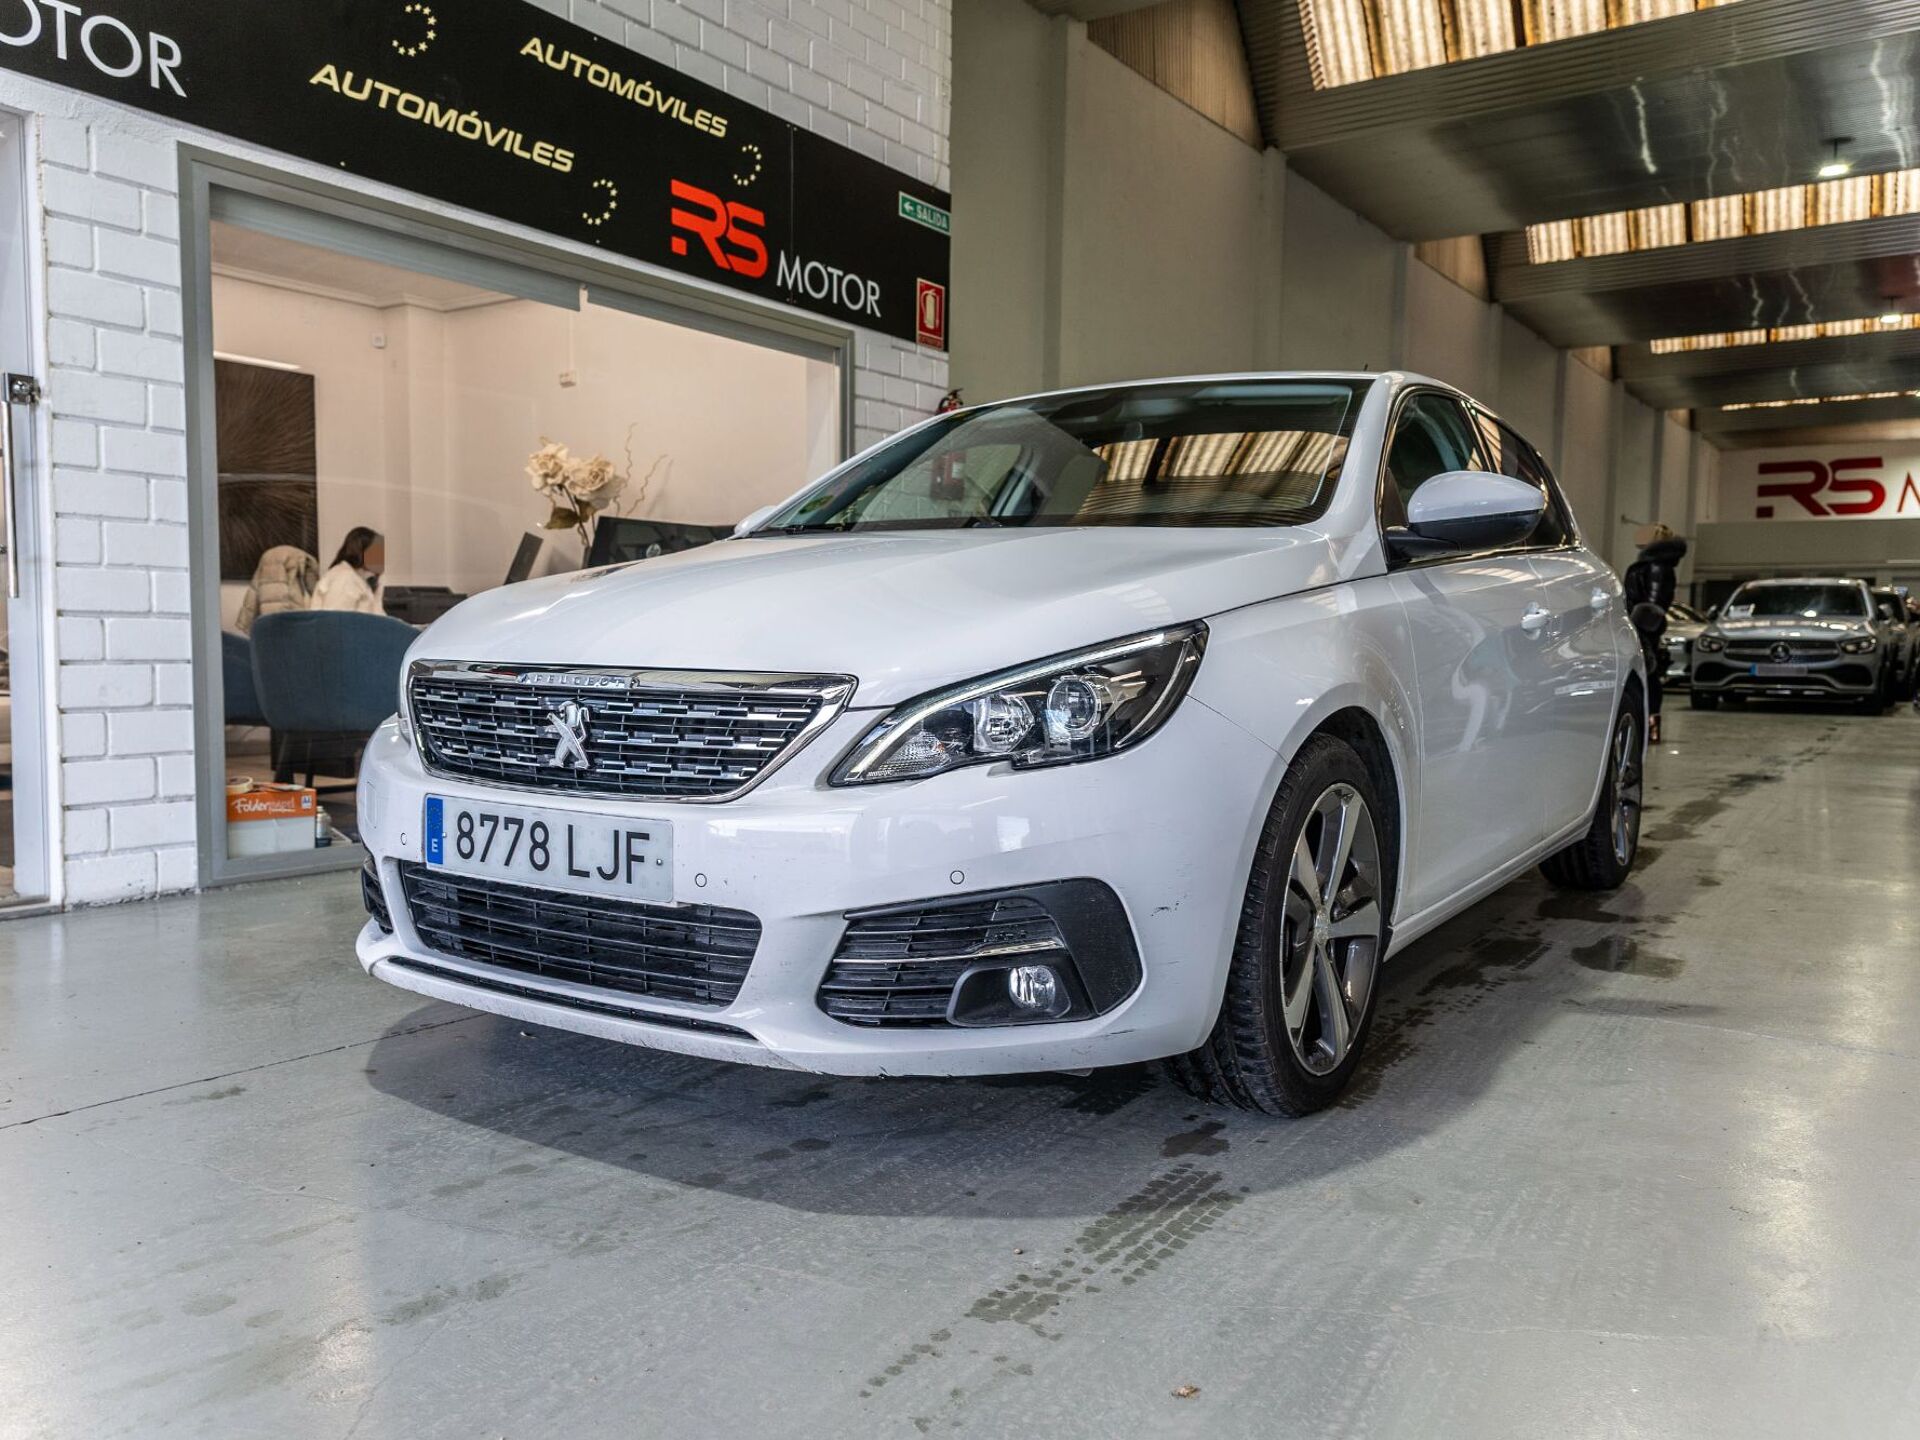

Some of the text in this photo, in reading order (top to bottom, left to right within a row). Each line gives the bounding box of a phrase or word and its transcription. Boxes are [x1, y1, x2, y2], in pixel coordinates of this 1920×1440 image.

[309, 63, 575, 173] AUTOMÓVILES
[520, 37, 728, 138] AUTOMÓVILES
[671, 178, 882, 318] RS MOTOR
[915, 204, 948, 230] SALIDA
[1756, 456, 1886, 518] RS
[533, 673, 626, 687] PEUGEOT
[431, 838, 439, 853] E
[456, 810, 650, 884] 8778 LJF
